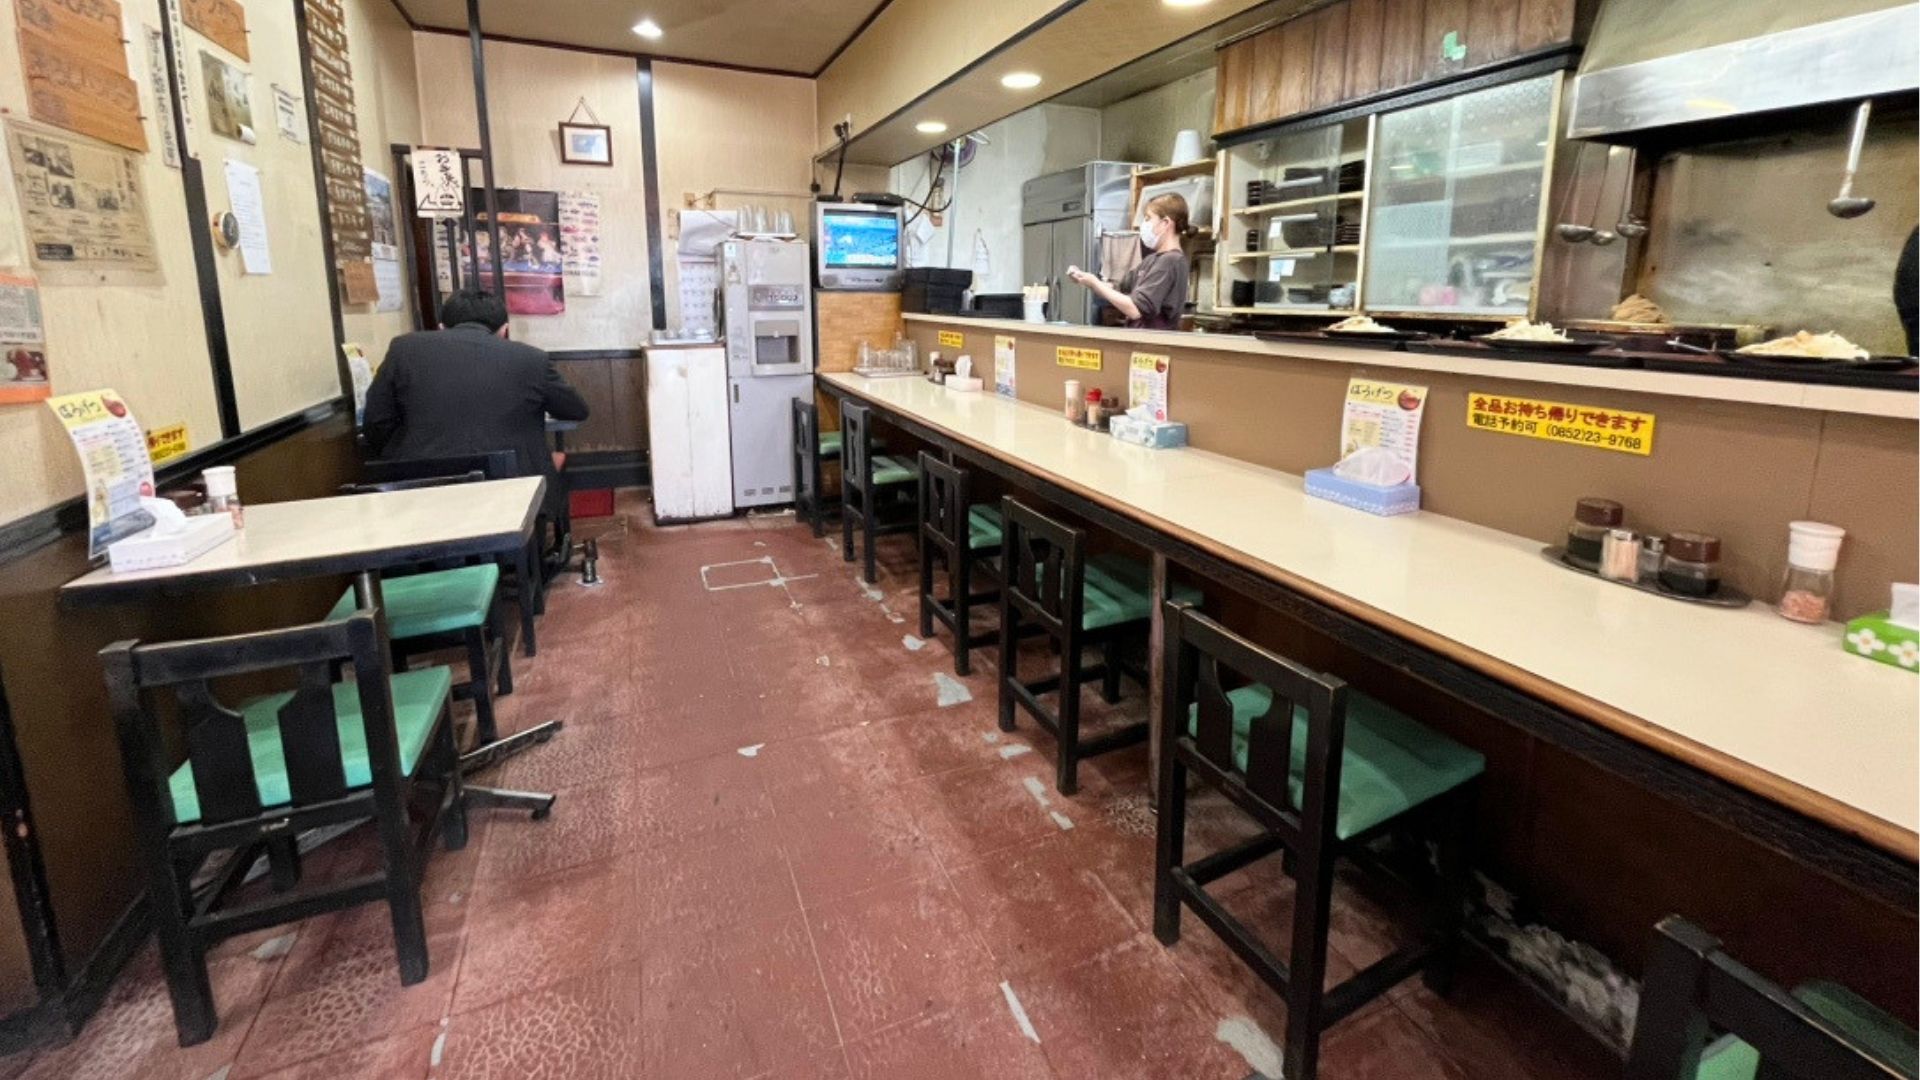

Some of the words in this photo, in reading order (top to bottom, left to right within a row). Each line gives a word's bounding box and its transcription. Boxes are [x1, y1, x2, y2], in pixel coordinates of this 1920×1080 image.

[1472, 412, 1538, 433] 電話予約可
[1546, 424, 1642, 449] (0852)23-9768
[1473, 397, 1646, 433] 全品お持ち帰りできます
